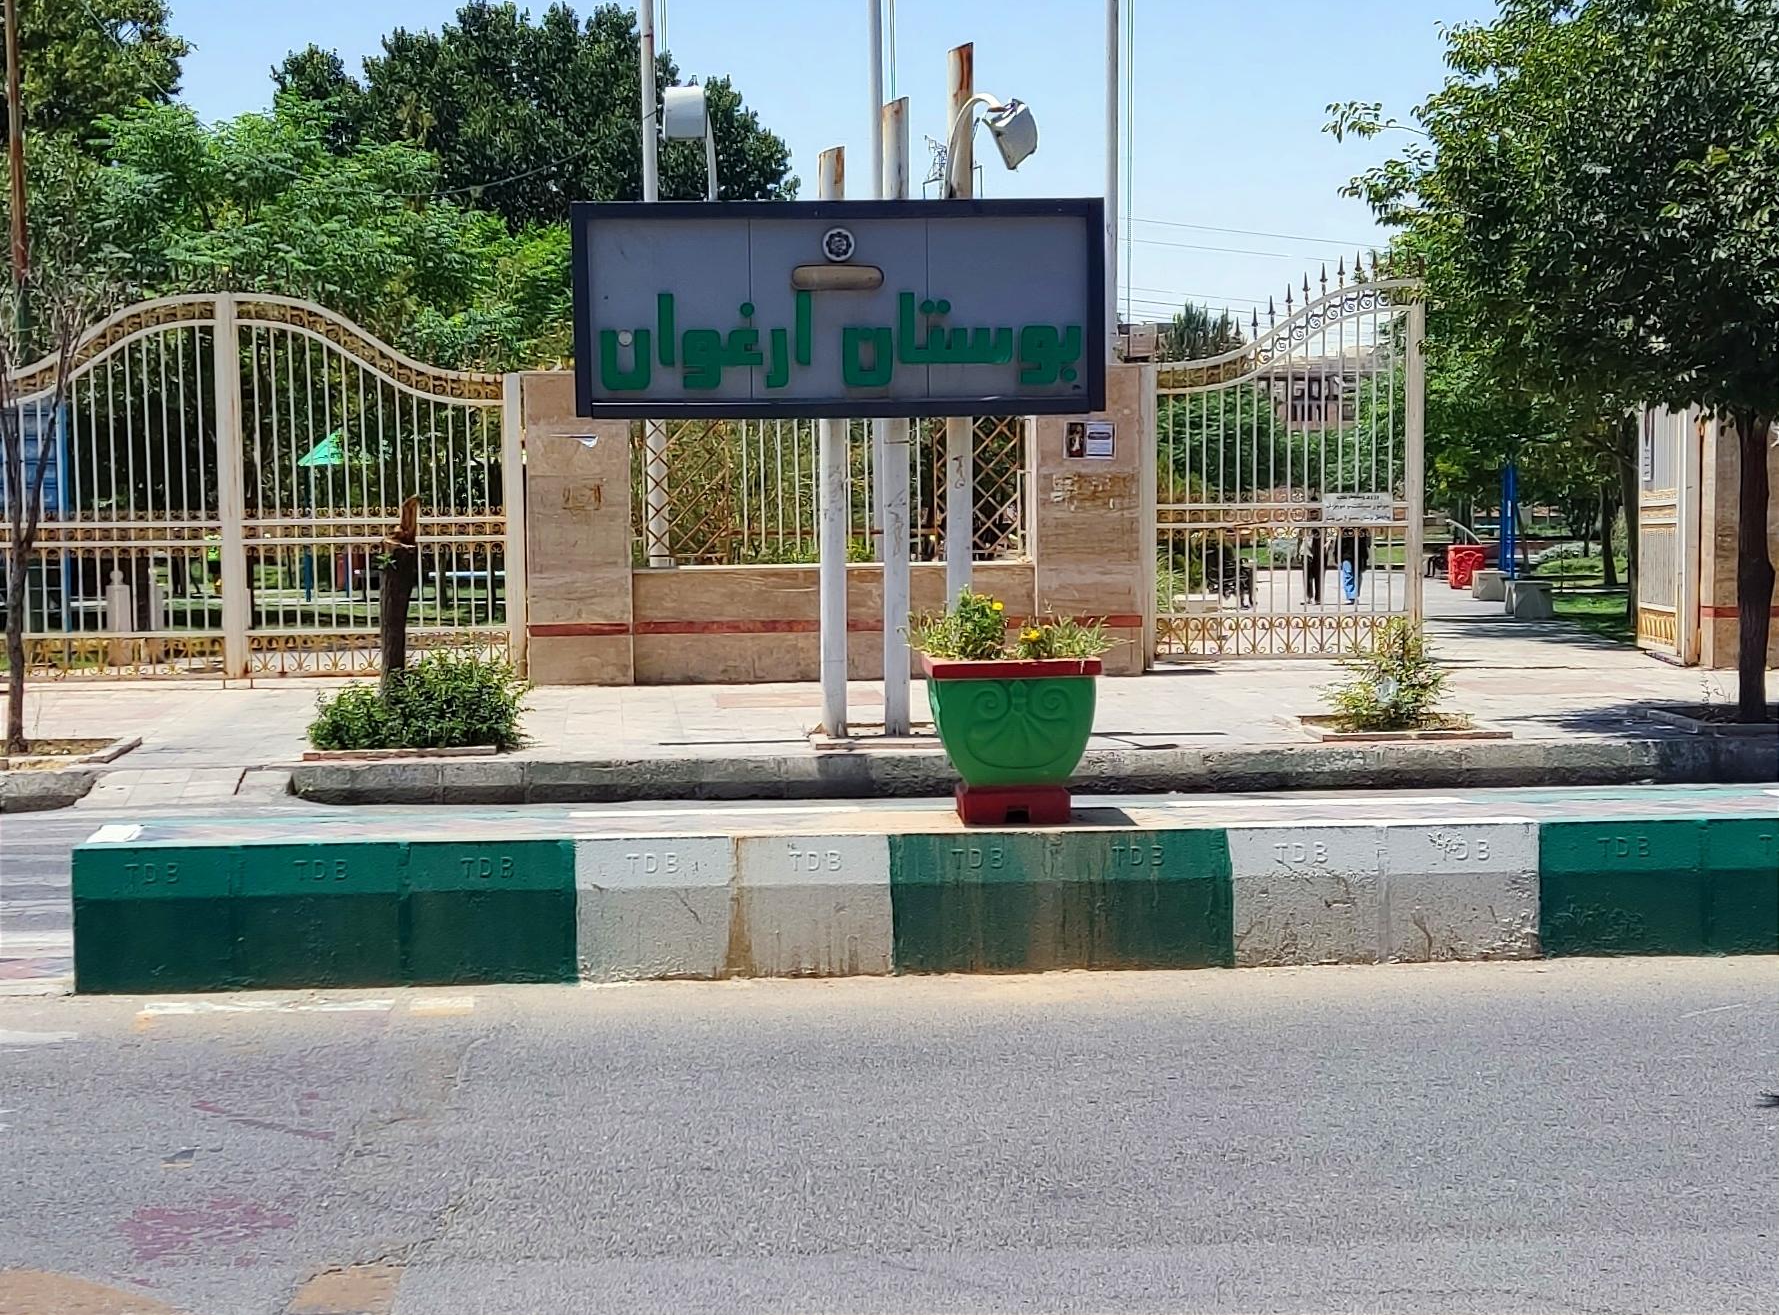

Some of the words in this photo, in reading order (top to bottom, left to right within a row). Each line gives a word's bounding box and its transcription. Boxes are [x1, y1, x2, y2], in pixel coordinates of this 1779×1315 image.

[600, 290, 812, 391] ارغوان
[842, 292, 1082, 388] بوستان
[1112, 846, 1164, 868] TDB
[1274, 842, 1328, 864] TDB
[1597, 836, 1649, 858] TDB
[460, 856, 514, 879] TDB
[626, 853, 679, 874] TDB
[789, 850, 842, 872] TDB
[951, 848, 1004, 869] TDB
[293, 859, 348, 881] TDB
